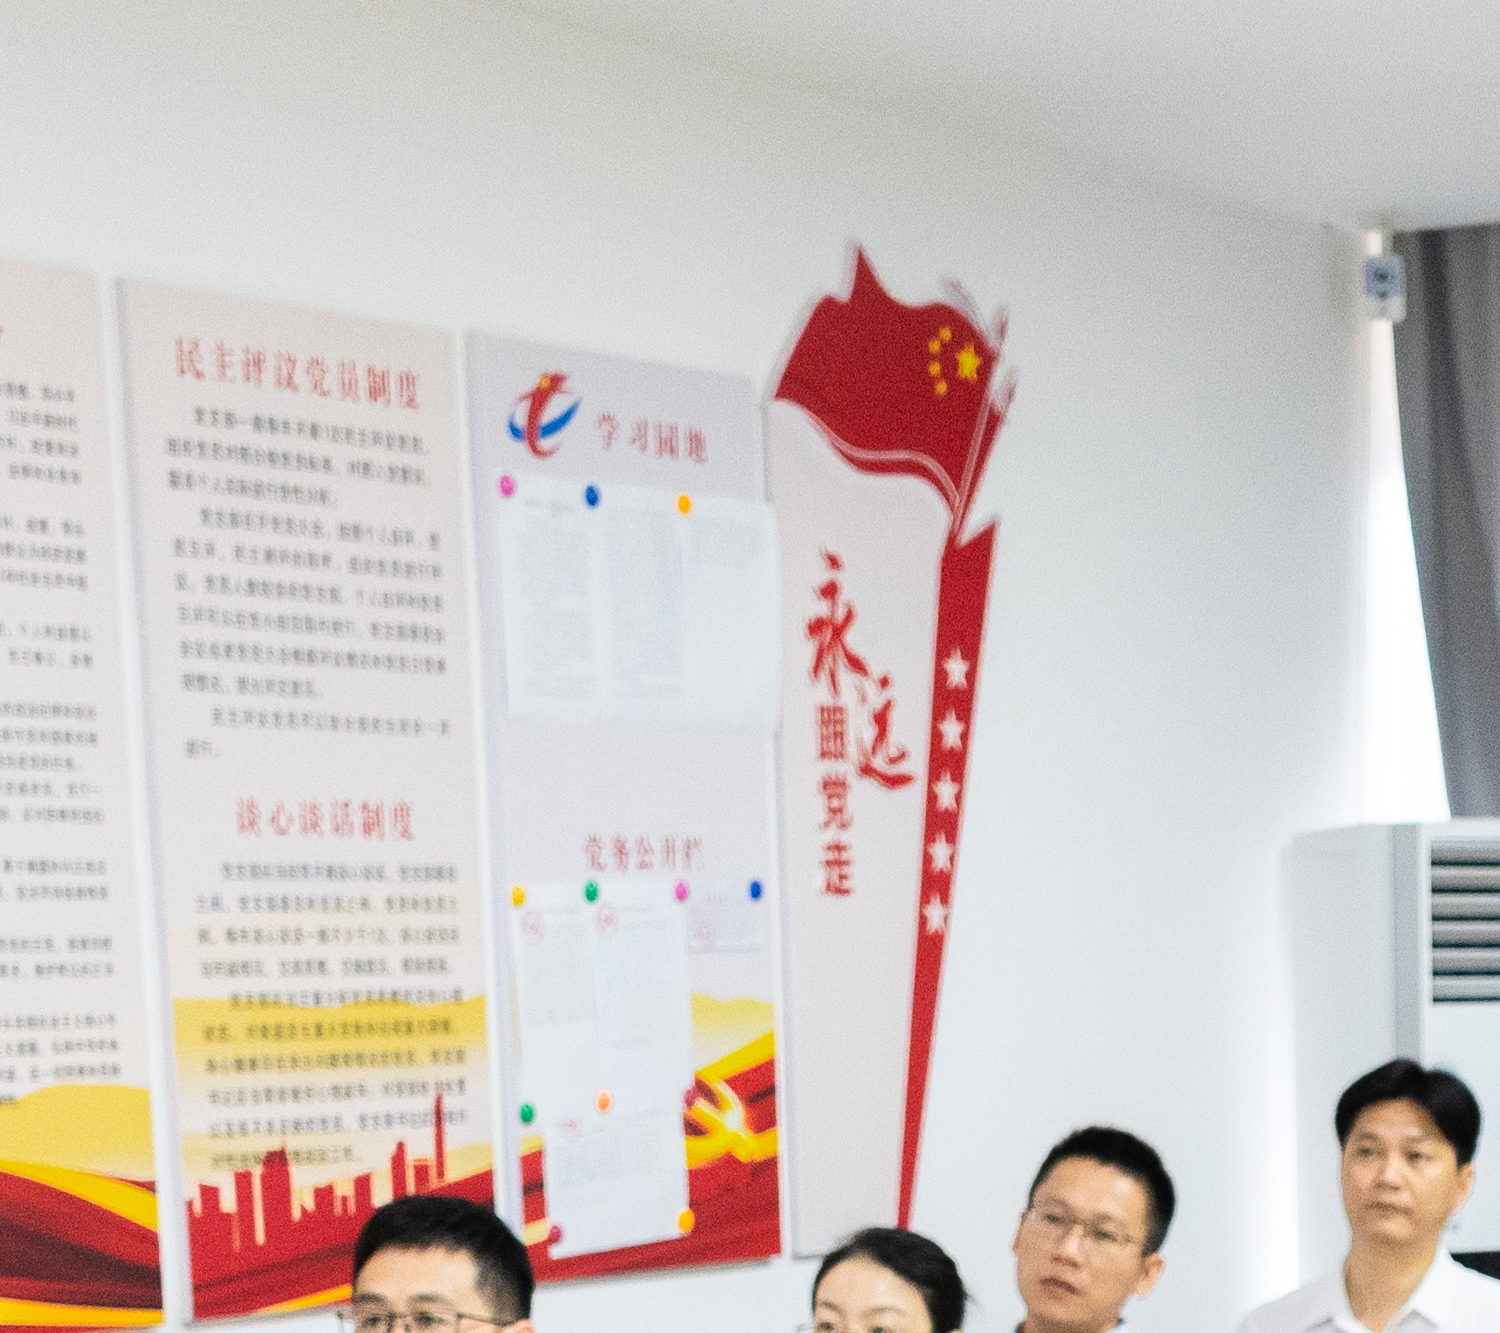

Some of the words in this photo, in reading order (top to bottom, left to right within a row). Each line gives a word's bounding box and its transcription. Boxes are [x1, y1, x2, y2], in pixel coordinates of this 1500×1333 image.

[175, 337, 421, 410] 民主评议党员制度
[236, 795, 414, 841] 谈心谈话制度
